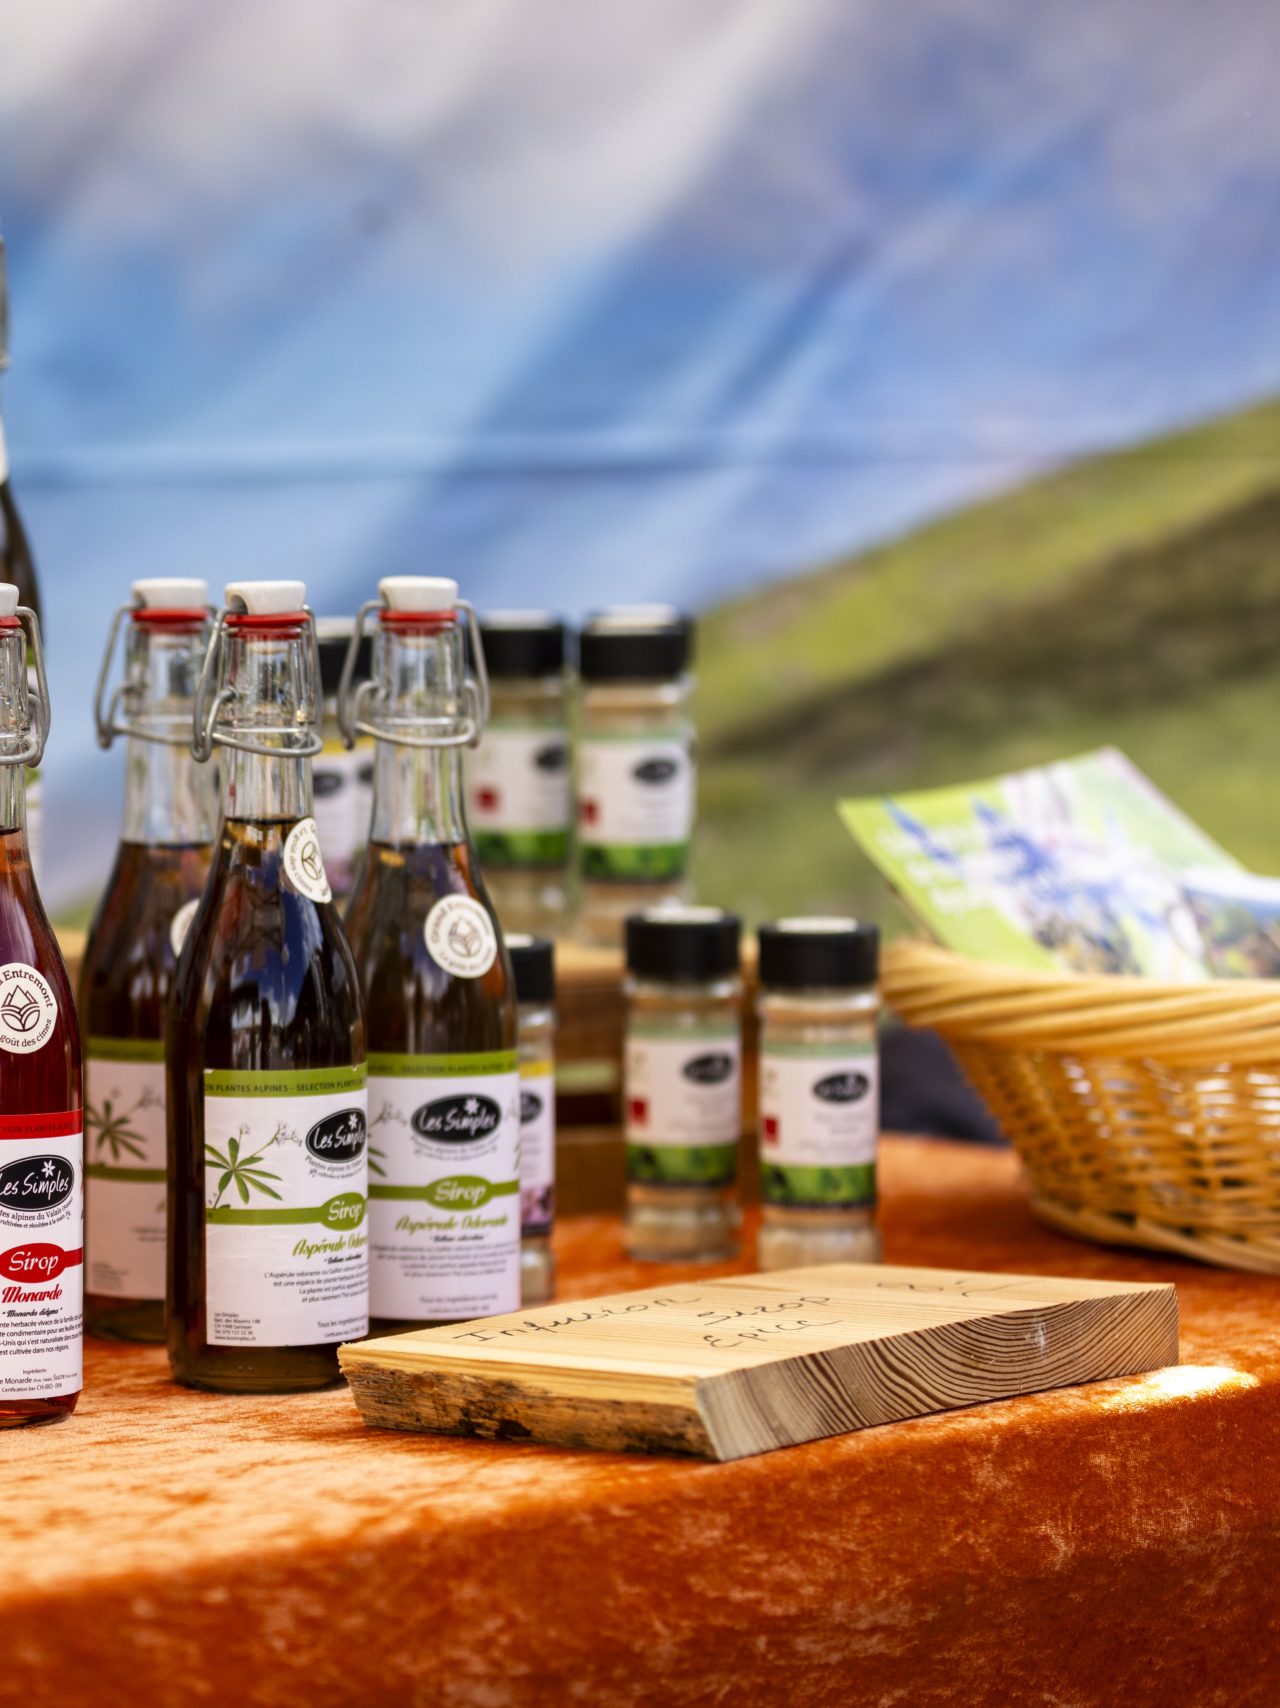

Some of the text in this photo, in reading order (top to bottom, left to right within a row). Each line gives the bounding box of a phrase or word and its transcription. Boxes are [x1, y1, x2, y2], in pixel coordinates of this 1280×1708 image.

[2, 968, 54, 1008] Entremont
[0, 1033, 20, 1048] goût
[21, 1038, 36, 1048] des
[36, 1018, 52, 1042] cimes
[216, 1084, 251, 1092] PLANTES
[253, 1084, 288, 1092] ALPINES
[296, 1080, 336, 1092] SELECTION
[419, 1108, 442, 1132] Les
[444, 1106, 496, 1137] Simples
[314, 1127, 334, 1150] Les
[22, 1168, 69, 1200] Simples
[434, 1180, 487, 1206] Sirop
[11, 1213, 36, 1222] alpines
[327, 1201, 362, 1224] Sirop
[292, 1236, 346, 1260] Aspérule
[8, 1251, 59, 1276] Sirop
[1, 1284, 63, 1304] Monarde
[11, 1320, 37, 1328] herbacée
[451, 1296, 703, 1342] Infusion
[6, 1329, 46, 1337] condimentaire
[16, 1340, 27, 1348] qui
[28, 1338, 40, 1346] s'est
[32, 1346, 45, 1354] dans
[4, 1376, 32, 1384] Monarde
